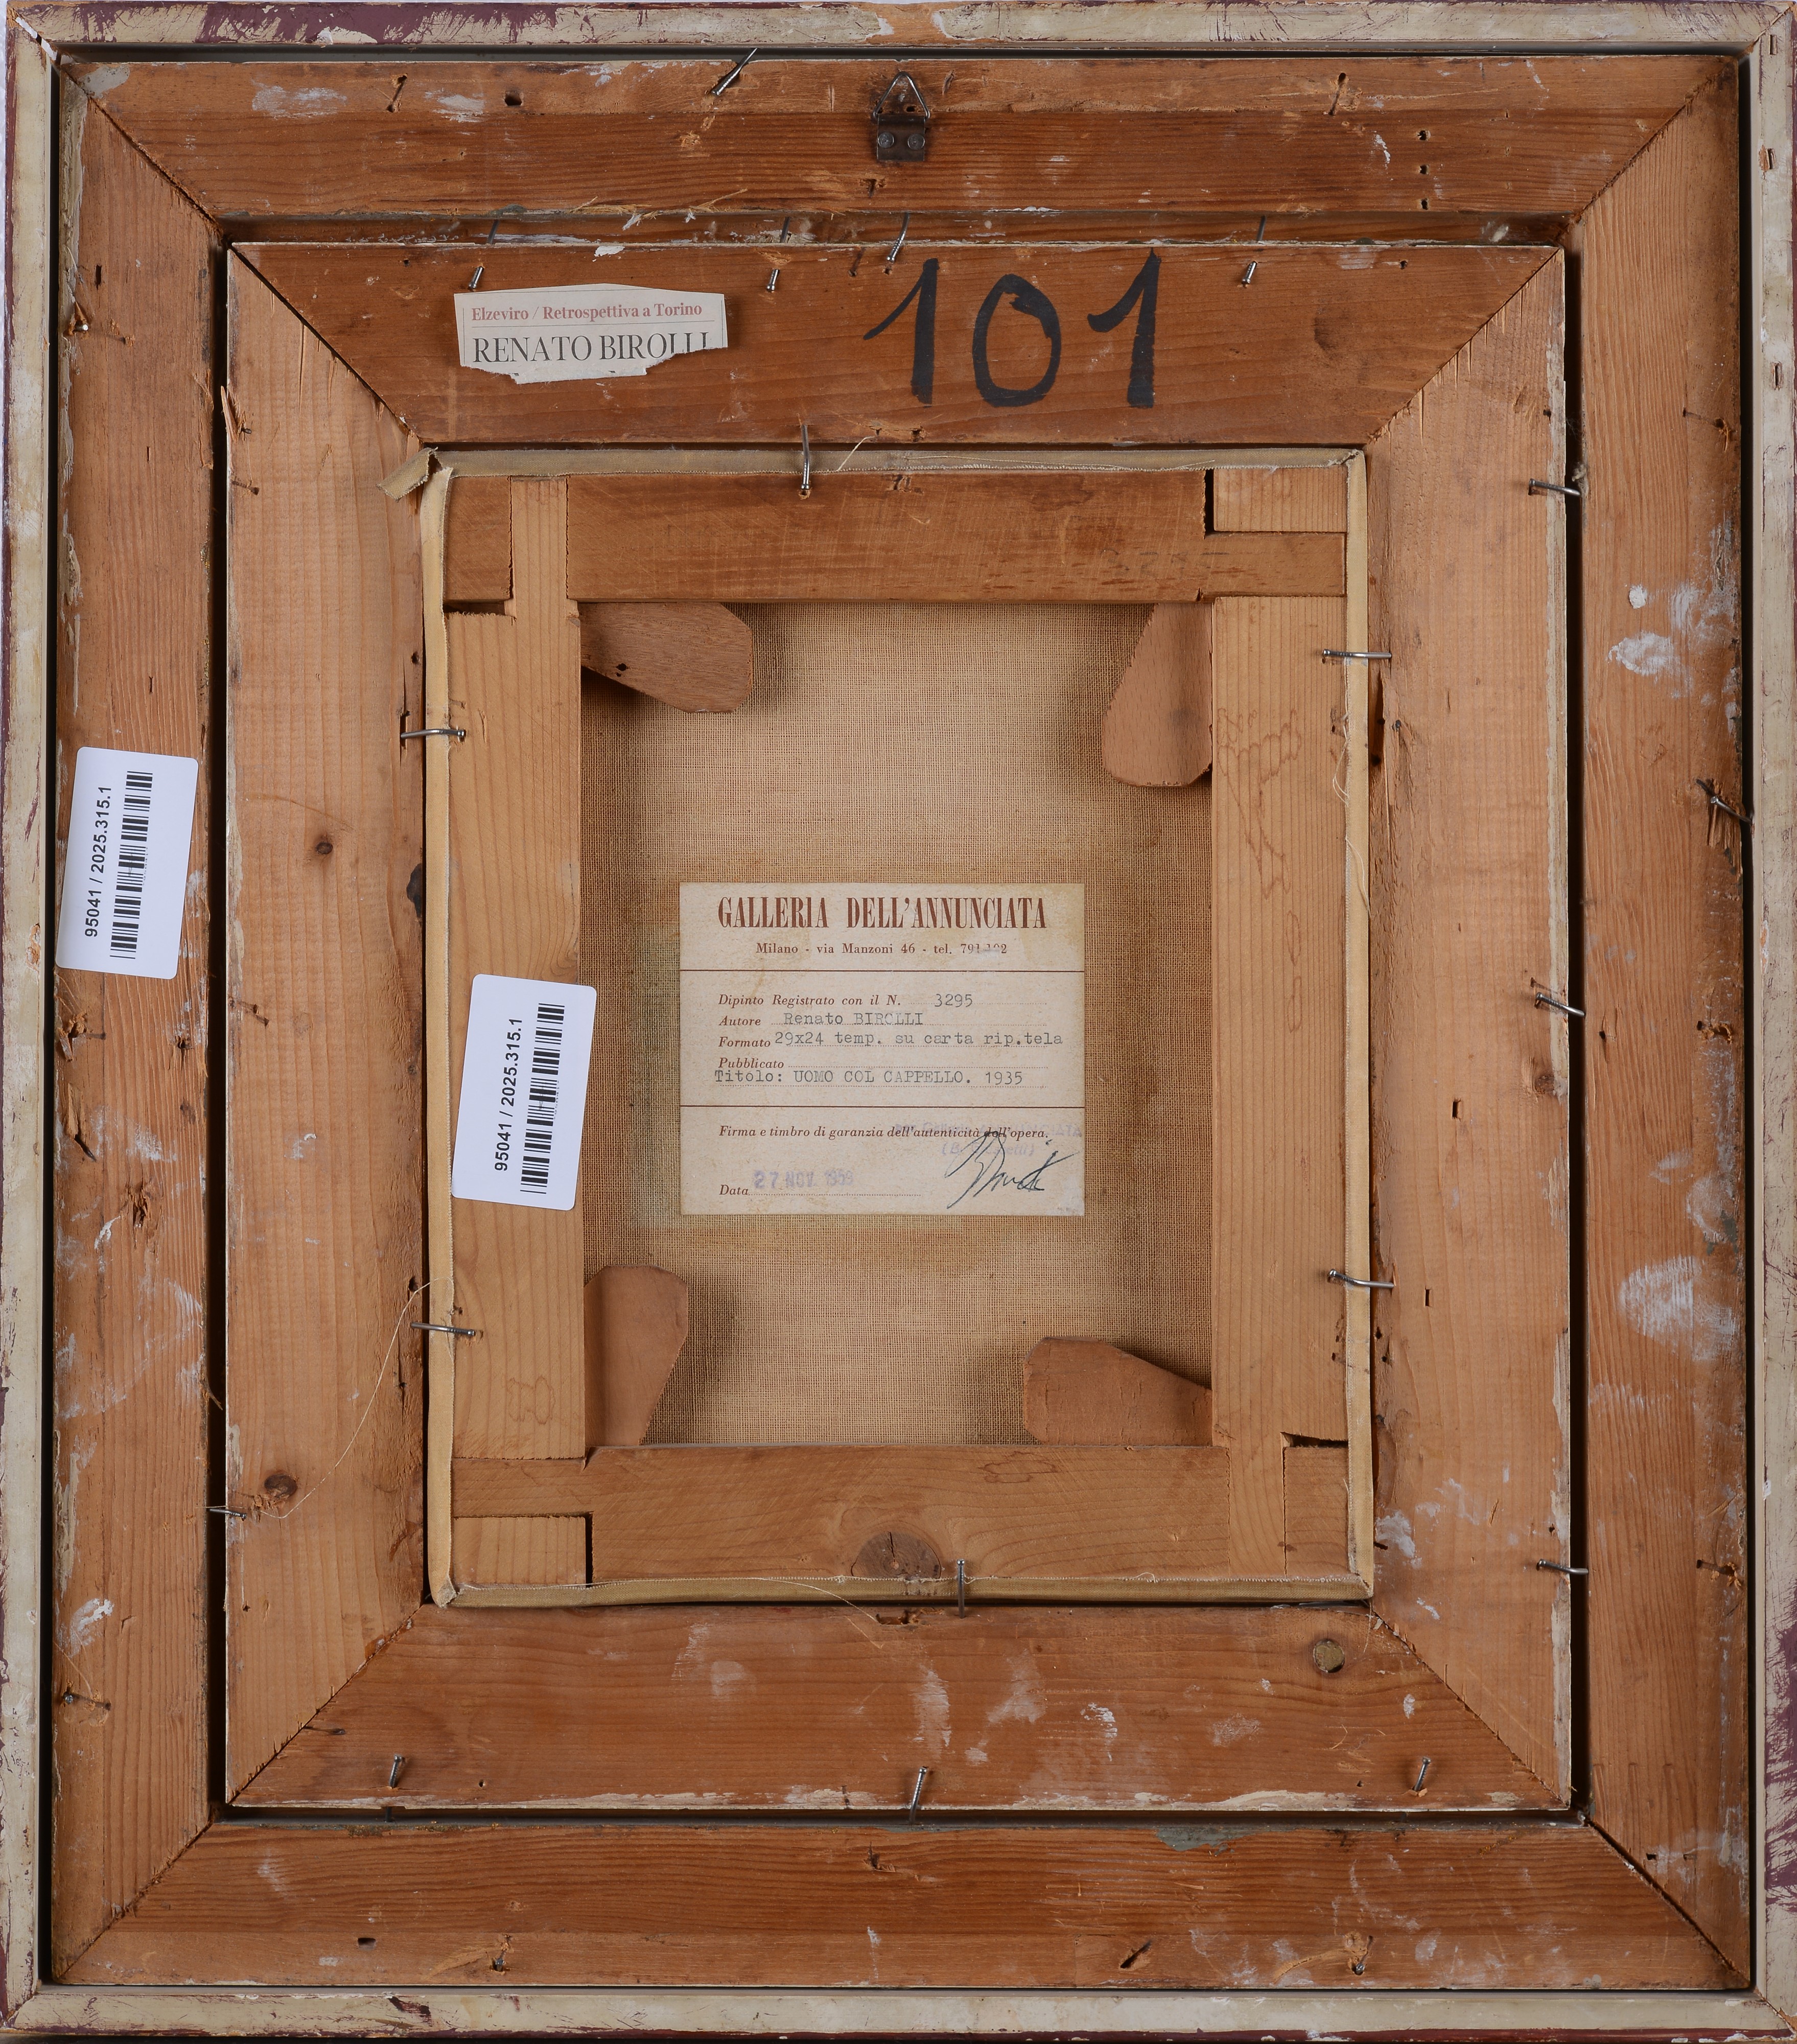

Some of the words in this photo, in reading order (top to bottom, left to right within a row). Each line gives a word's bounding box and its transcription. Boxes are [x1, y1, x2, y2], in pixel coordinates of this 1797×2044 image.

[472, 307, 528, 320] Elzeviro
[543, 305, 639, 322] Retrospettiva
[643, 308, 651, 316] a
[654, 303, 702, 316] Torino
[864, 248, 1161, 408] 101
[473, 336, 591, 362] RENATO
[90, 786, 112, 874] 2025.315.1
[84, 890, 102, 938] 95041
[718, 897, 829, 928] GALLERIA
[847, 897, 1047, 928] DELL'ANNUNCIATA
[756, 943, 798, 953] Milano
[817, 944, 834, 953] via
[842, 943, 893, 953] Manzoni
[901, 943, 915, 953] 46
[934, 944, 951, 954] tel.
[718, 994, 764, 1008] Dipinto
[772, 994, 834, 1008] Registrato
[871, 995, 879, 1005] il
[886, 995, 900, 1005] N.
[935, 994, 972, 1008] 3295
[718, 1015, 760, 1026] Autore
[783, 1011, 844, 1024] Renato
[718, 1037, 771, 1047] Formato
[775, 1032, 824, 1046] 29x24
[834, 1032, 882, 1047] temp.
[896, 1034, 915, 1044] su
[924, 1032, 973, 1044] carta
[984, 1032, 1063, 1047] rip.tela
[501, 1018, 522, 1106] 2025.315.1
[718, 1057, 784, 1068] Pubblicato
[715, 1070, 782, 1083] Titolo:
[794, 1070, 833, 1082] UOMO
[844, 1070, 875, 1082] COL
[884, 1070, 972, 1083] CAPPELLO.
[985, 1072, 1023, 1084] 1935
[719, 1126, 756, 1136] Firma
[770, 1126, 810, 1136] timbro
[814, 1126, 826, 1136] di
[828, 1127, 884, 1141] garanzia
[887, 1126, 980, 1137] dell'autenticità
[495, 1123, 511, 1171] 95041
[719, 1184, 748, 1195] Data
